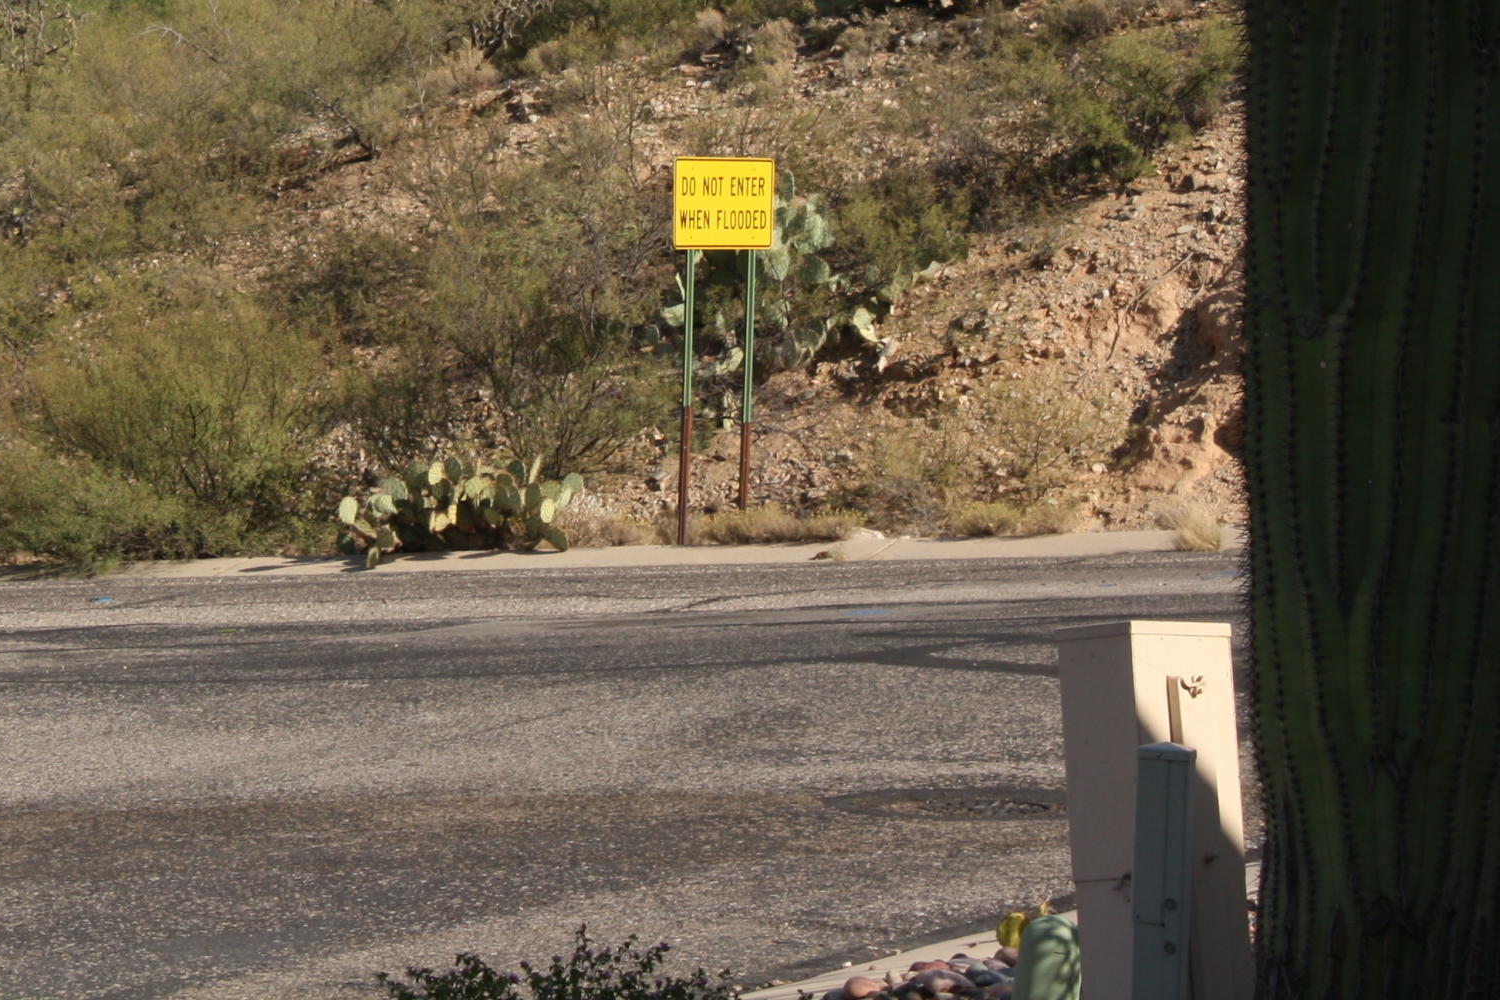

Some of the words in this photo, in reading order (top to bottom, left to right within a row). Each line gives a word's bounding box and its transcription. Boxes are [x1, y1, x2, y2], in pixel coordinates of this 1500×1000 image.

[681, 176, 696, 196] DO
[703, 177, 724, 196] NOT
[730, 177, 765, 197] ENTER
[679, 209, 710, 230] WHEN
[717, 210, 767, 230] FLOODED
